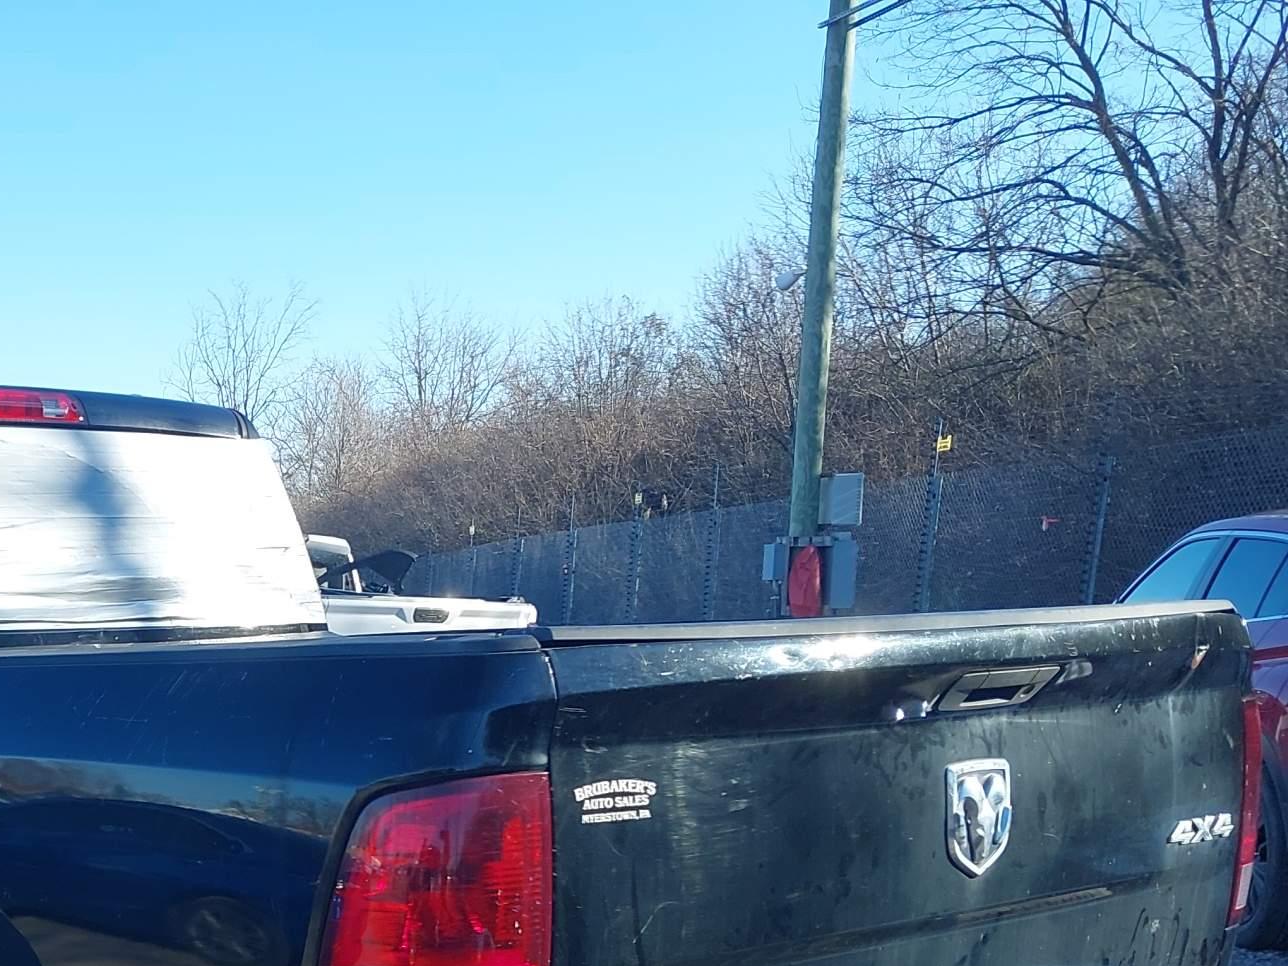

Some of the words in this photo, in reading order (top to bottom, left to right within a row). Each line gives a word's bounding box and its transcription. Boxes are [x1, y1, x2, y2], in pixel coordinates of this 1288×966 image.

[573, 778, 657, 802] BRUBAKER'S
[582, 797, 614, 811] AUTO
[614, 794, 650, 808] SALES
[1168, 812, 1235, 846] 4X4
